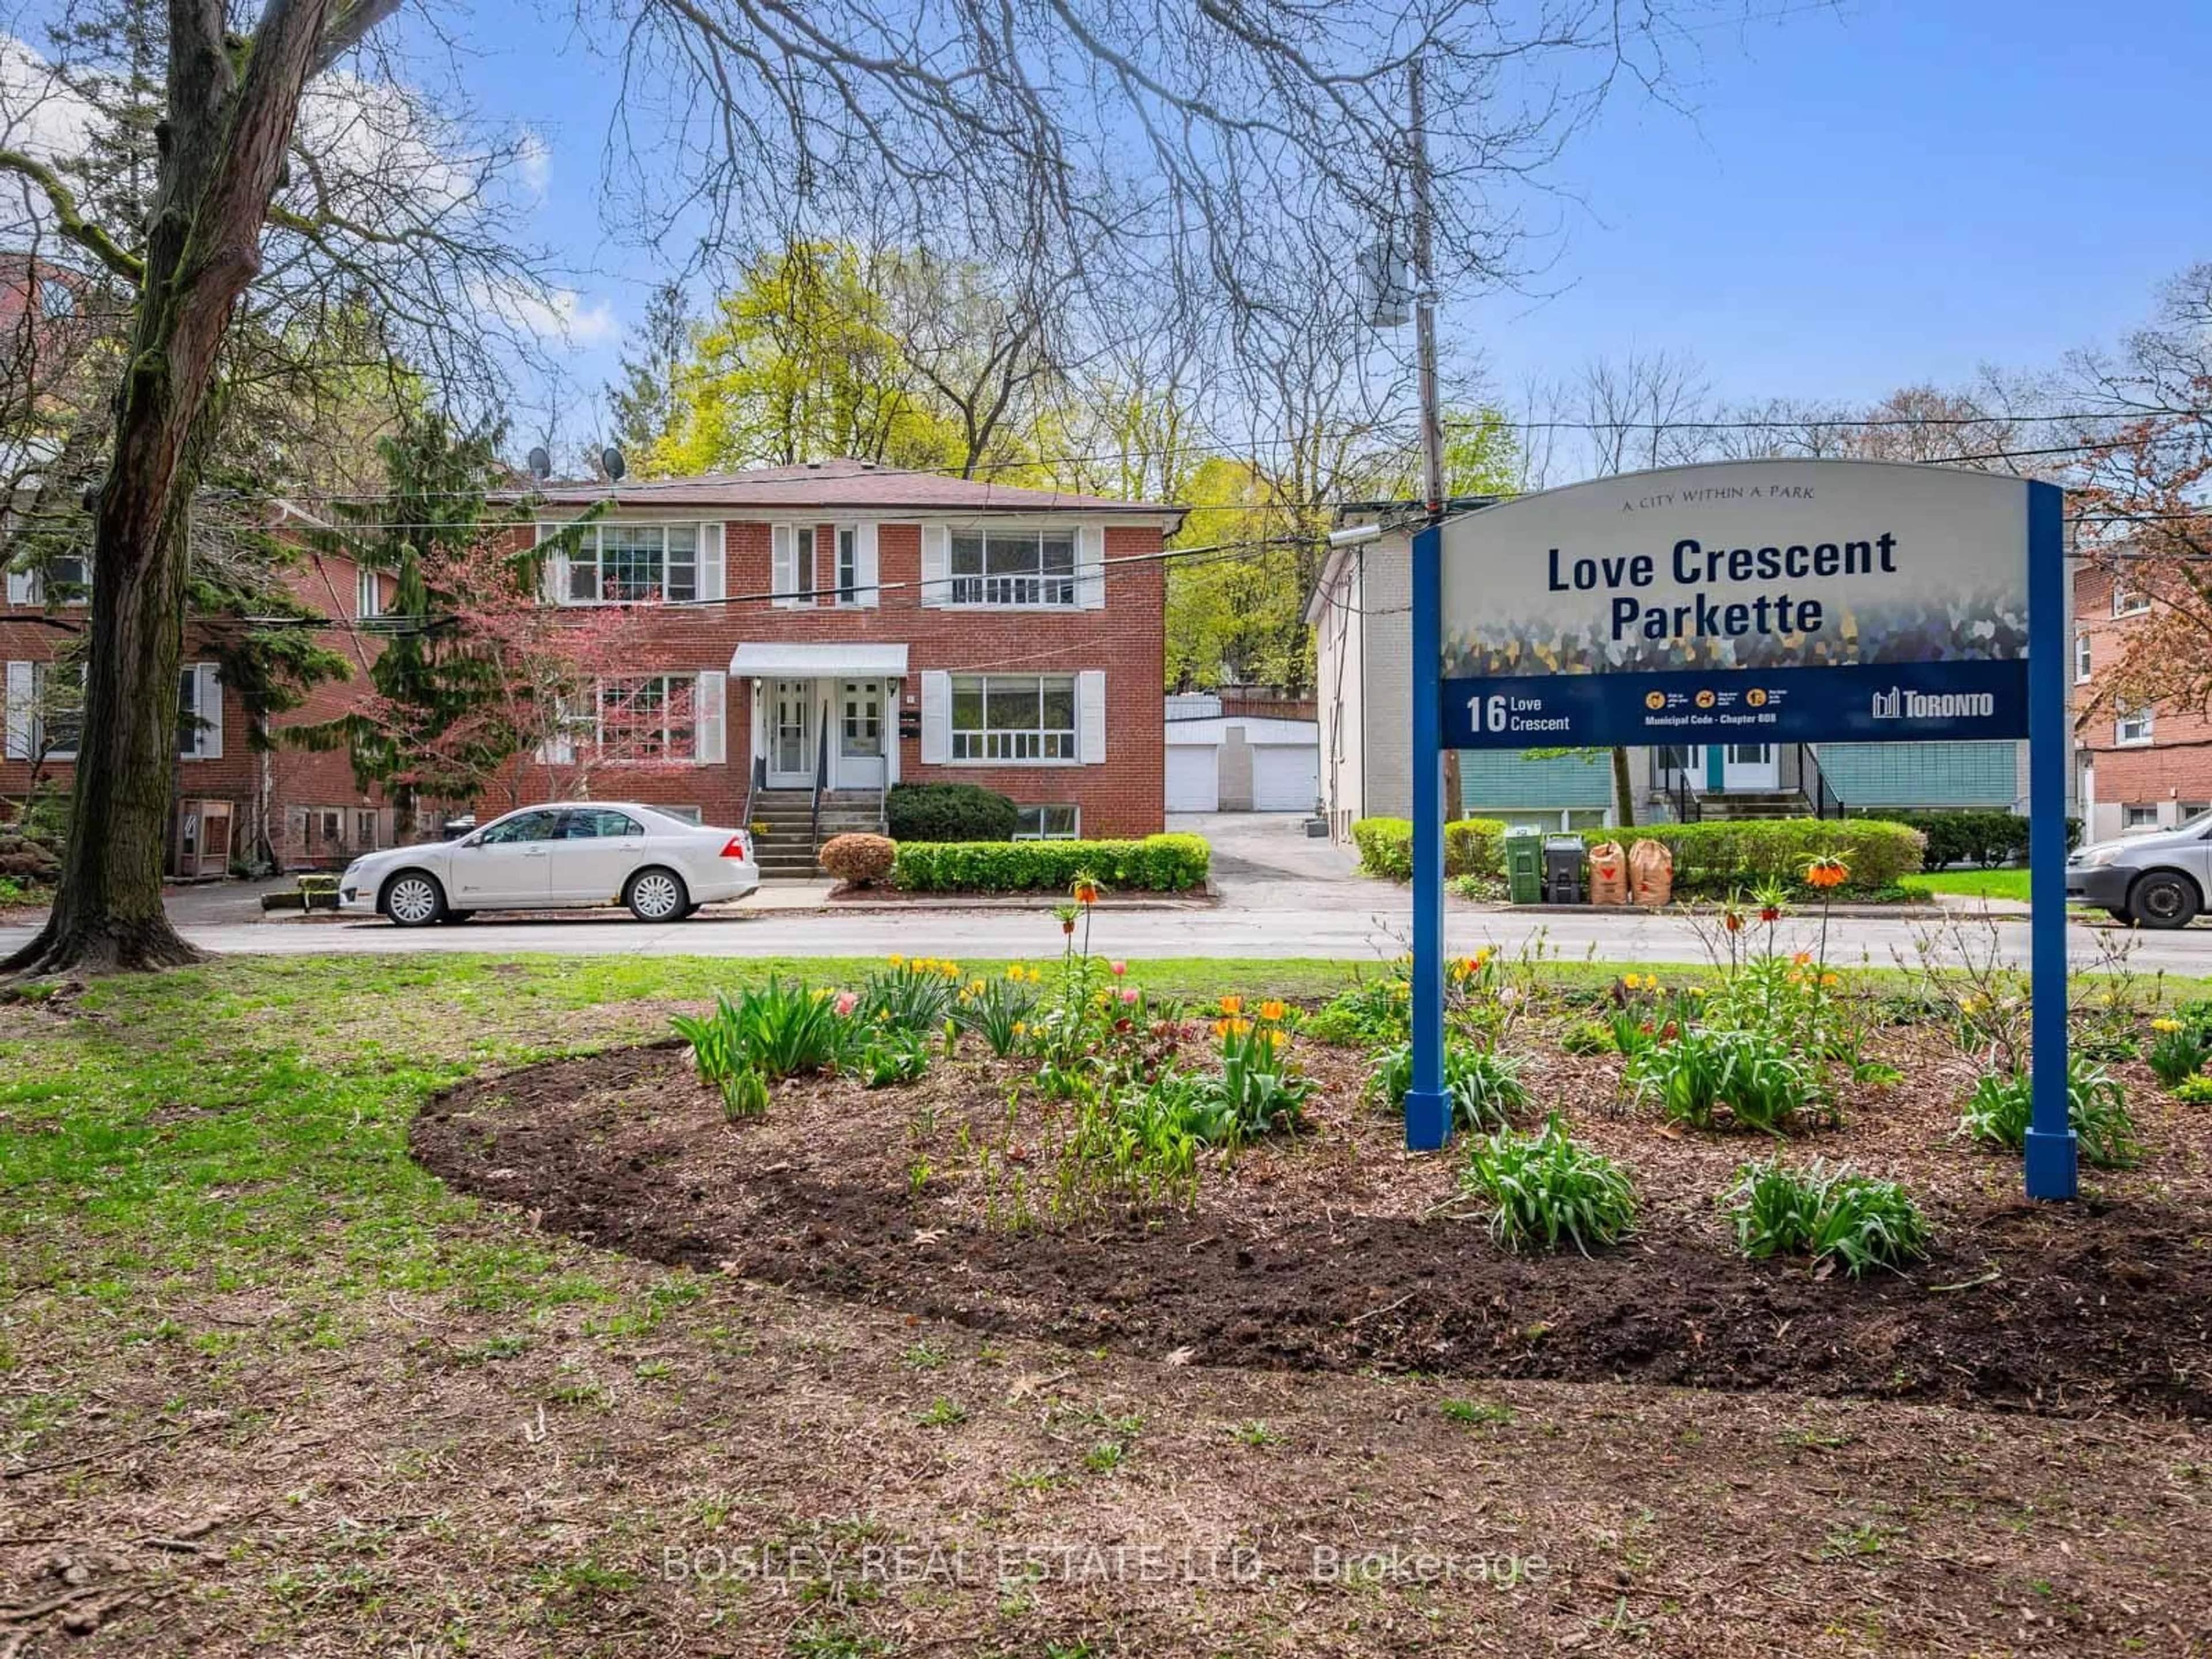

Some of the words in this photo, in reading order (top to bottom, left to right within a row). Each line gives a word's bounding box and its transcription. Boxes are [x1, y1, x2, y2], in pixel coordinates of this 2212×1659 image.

[1622, 500, 1634, 512] A
[1639, 493, 1675, 509] CITY
[1683, 487, 1743, 502] WITHIN
[1750, 487, 1762, 498] A
[1770, 485, 1815, 499] PARK
[1548, 548, 1654, 592] Love
[1672, 531, 1897, 585] Crescent
[1612, 593, 1823, 641] Parkette
[1467, 695, 1507, 733] 16
[1510, 696, 1542, 711] Love
[1903, 690, 1994, 718] TORONTO
[1510, 715, 1571, 732] Crescent
[1645, 715, 1688, 726] Municipal
[1690, 714, 1713, 725] Code
[1720, 714, 1756, 725] Chapter
